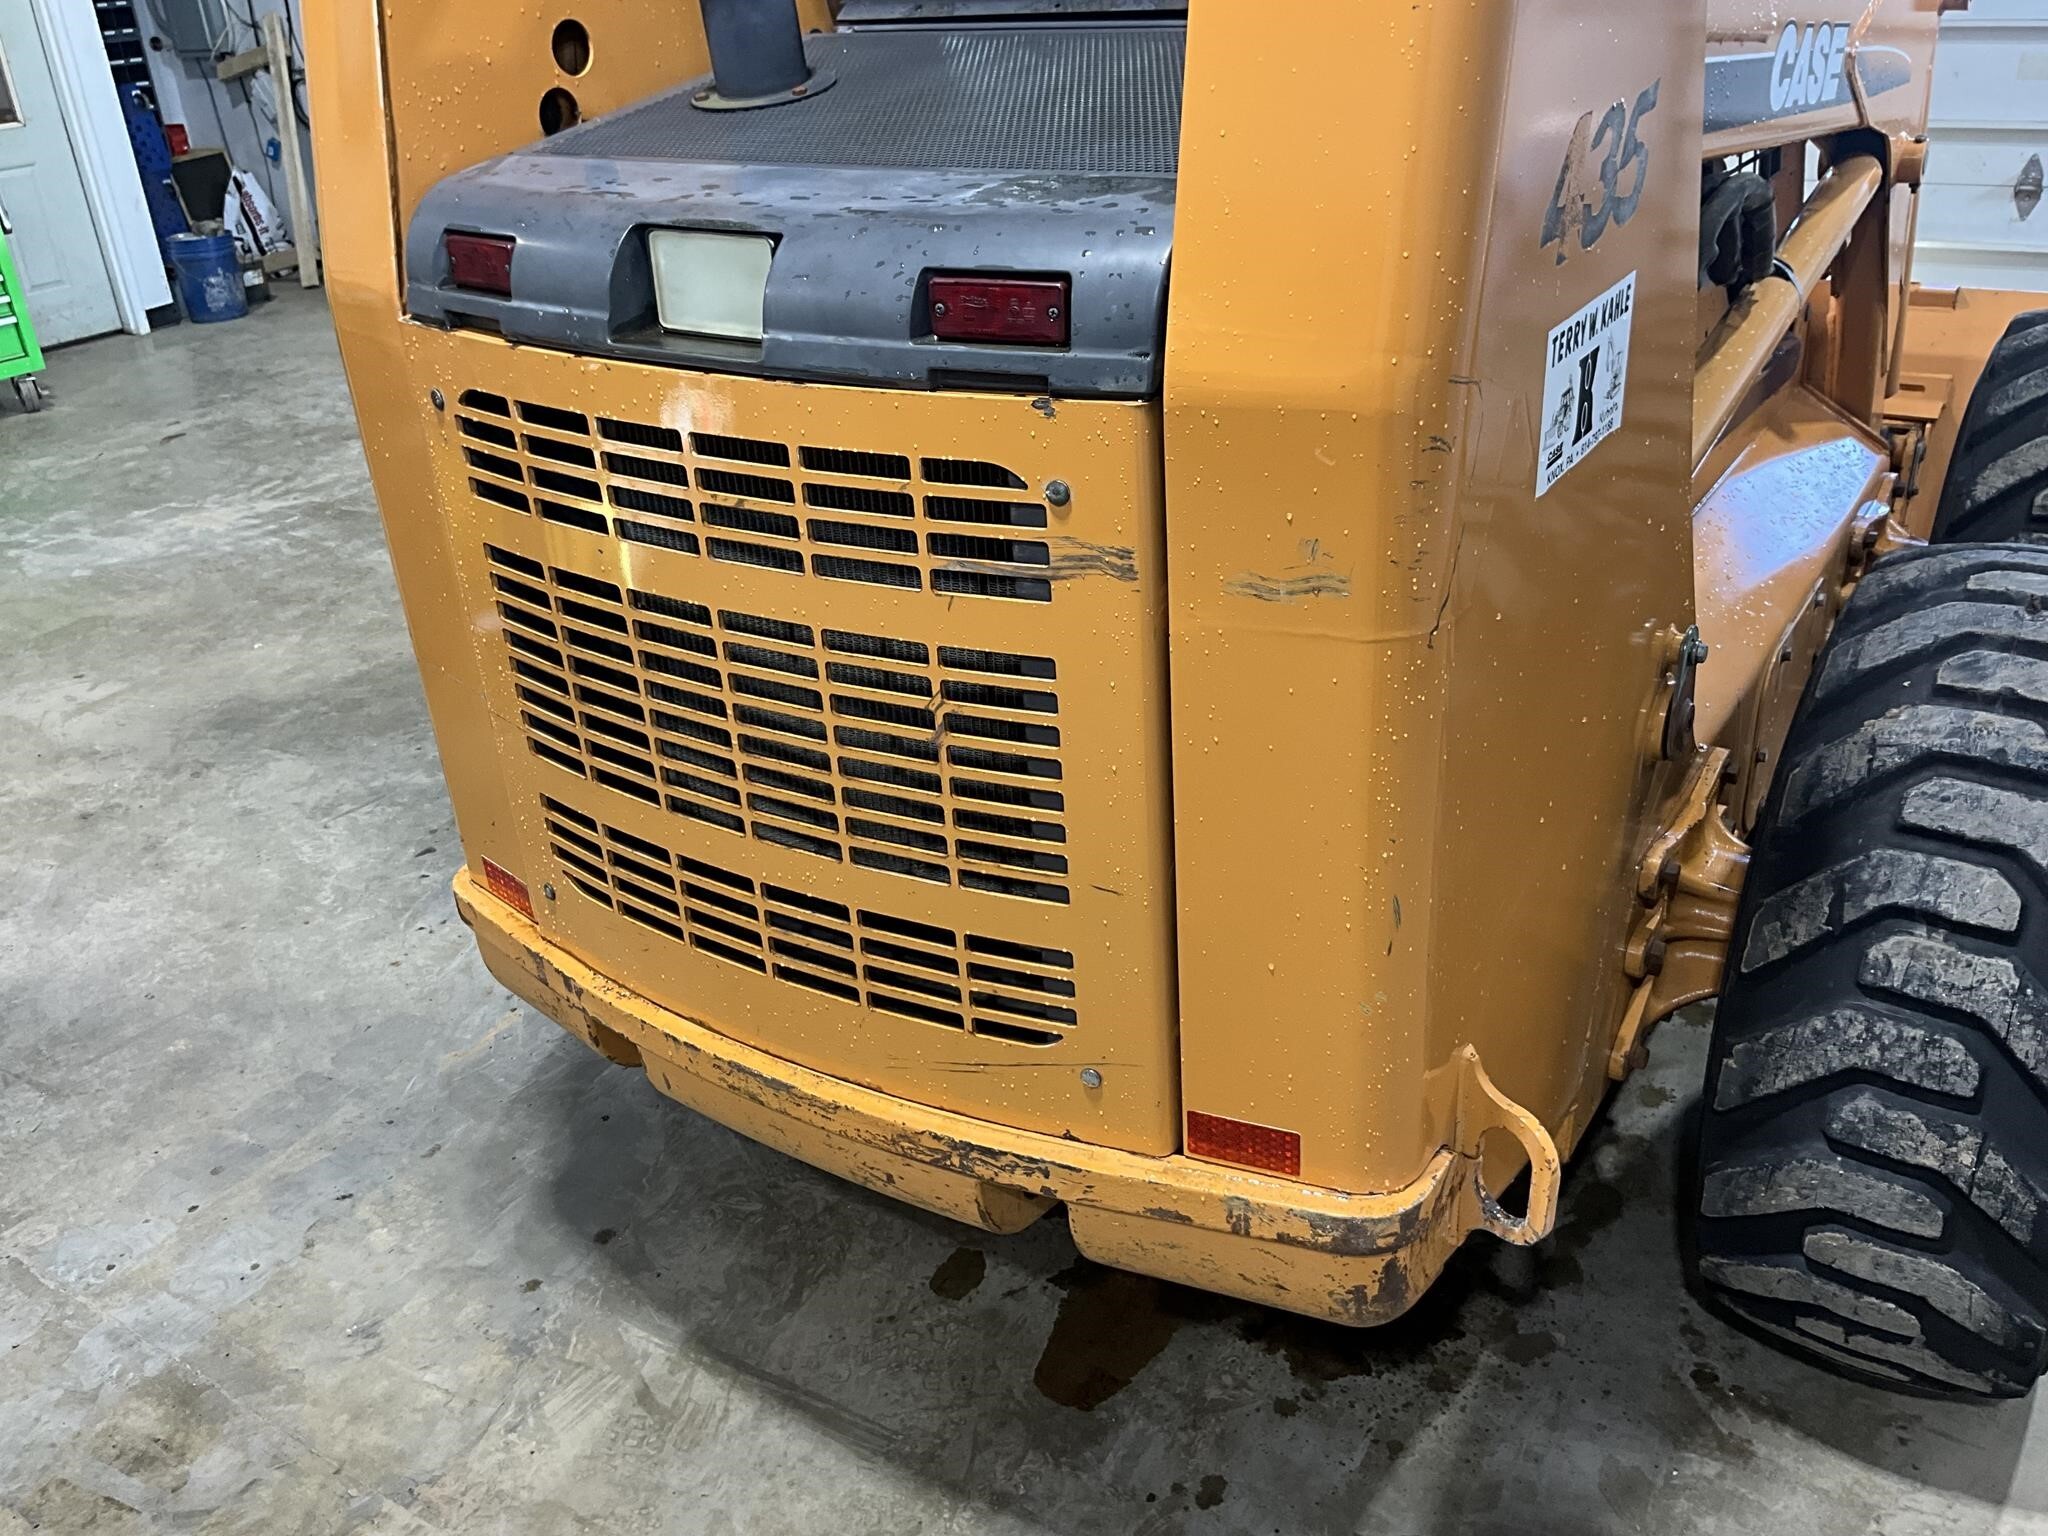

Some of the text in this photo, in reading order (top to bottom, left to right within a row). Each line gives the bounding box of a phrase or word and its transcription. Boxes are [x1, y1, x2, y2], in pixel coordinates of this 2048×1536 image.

[1769, 18, 1850, 112] CASE
[1551, 283, 1631, 369] TERRY W. KAHLE
[1547, 441, 1564, 461] CASE
